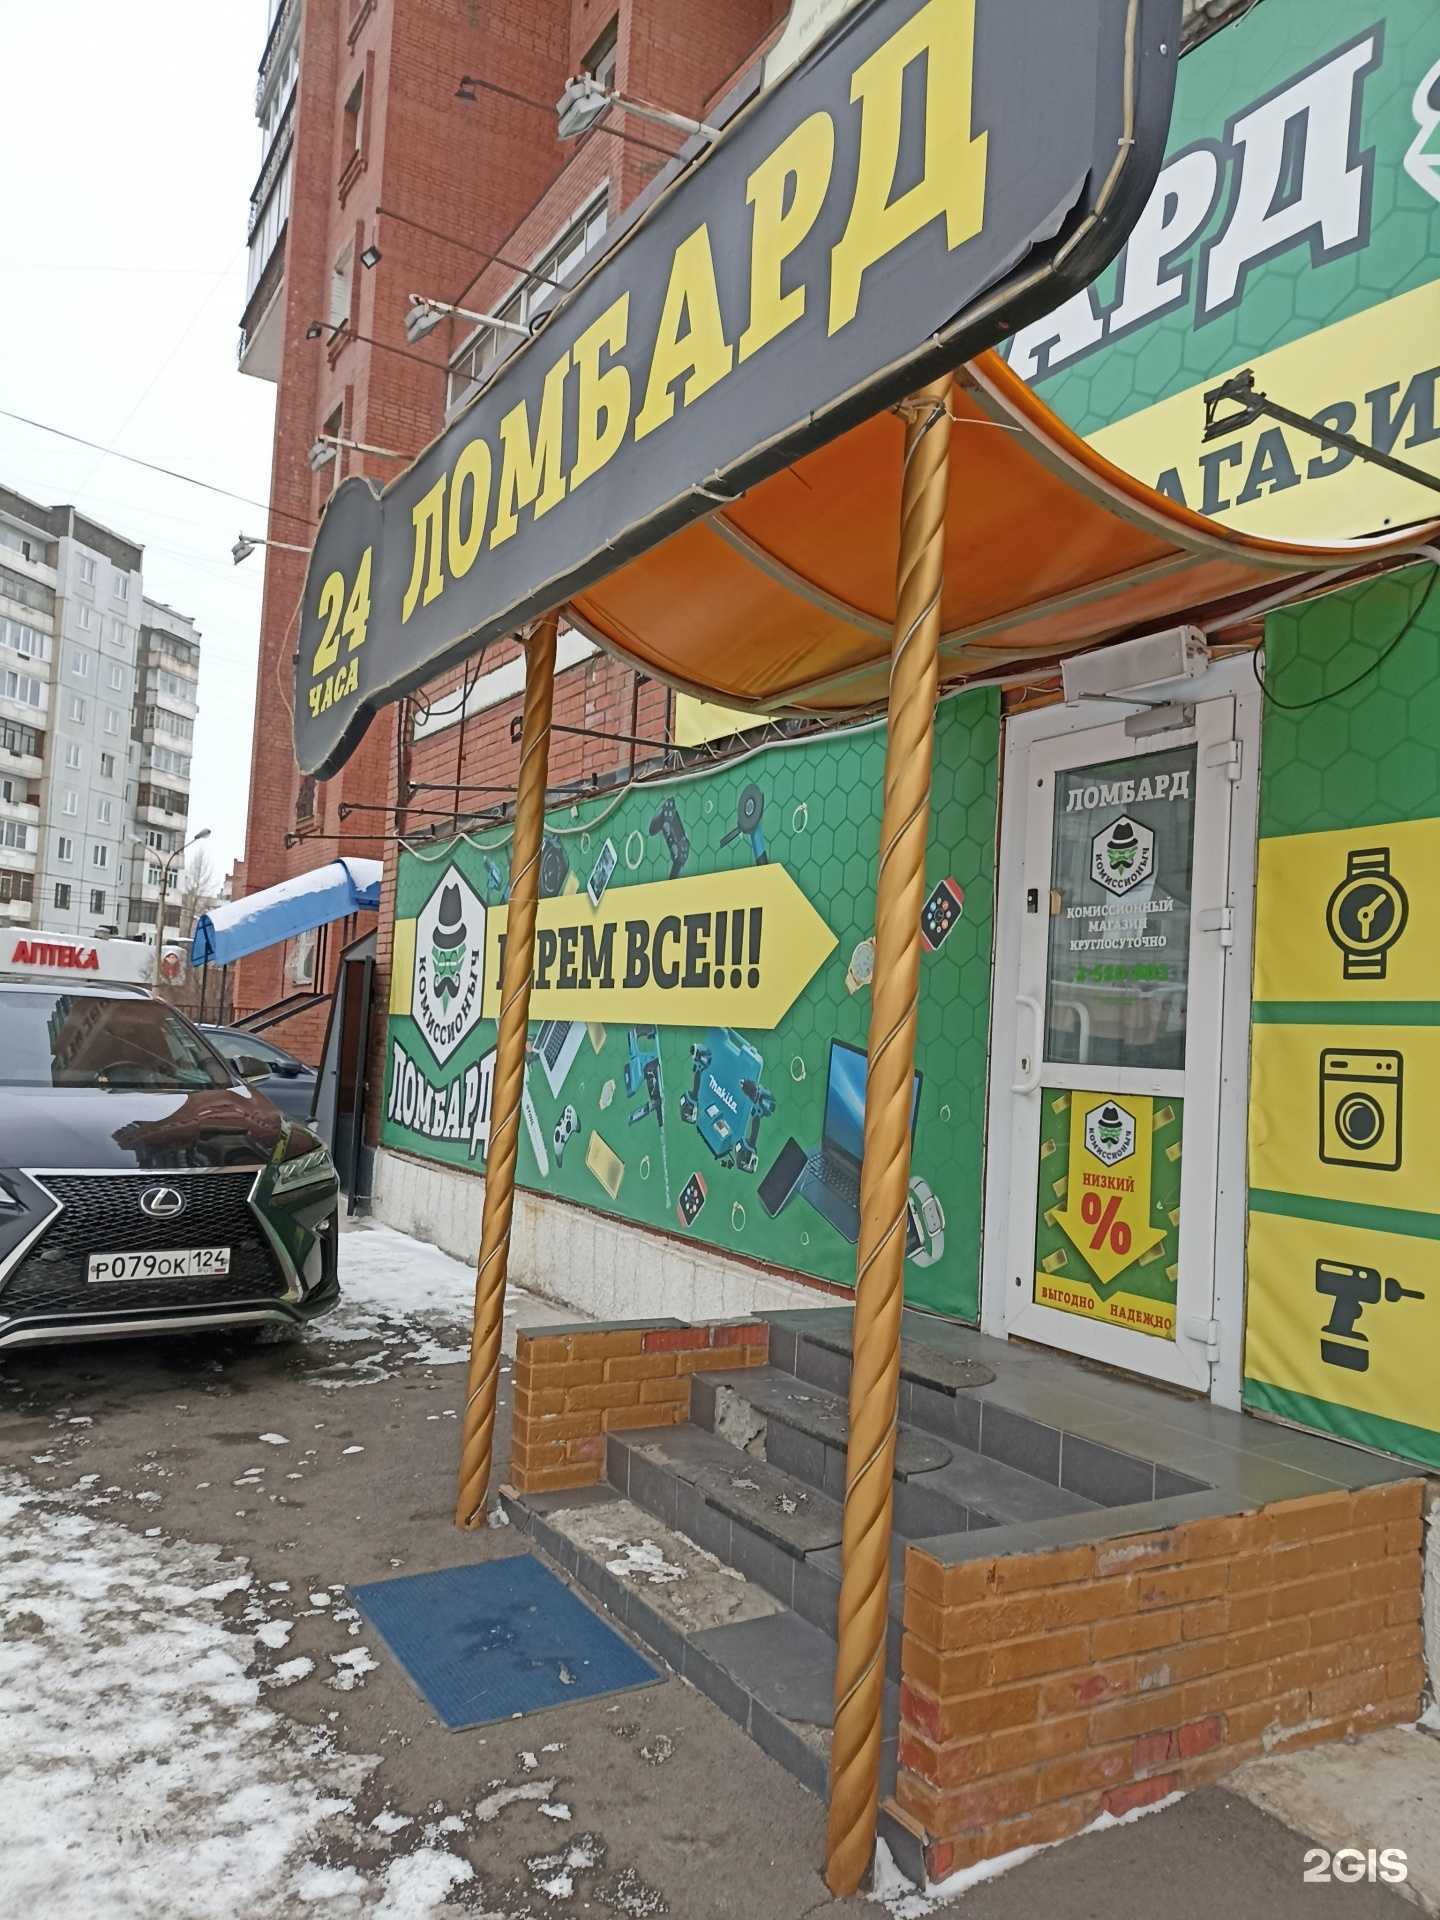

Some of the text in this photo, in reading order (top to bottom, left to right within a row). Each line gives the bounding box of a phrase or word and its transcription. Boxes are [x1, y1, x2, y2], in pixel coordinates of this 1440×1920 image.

[402, 0, 989, 625] ЛОМБАРД
[311, 546, 373, 677] 24
[309, 656, 360, 717] ЧАСА
[1066, 771, 1190, 812] ЛОМБАРД
[1066, 896, 1174, 920] КОМИССИОННЫЙ
[1088, 917, 1148, 934] МАГАЗИН
[11, 939, 99, 970] АПТЕКА
[496, 906, 763, 990] РЕМ ВСЕ!!!
[1069, 934, 1167, 951] КРУГЛОСУТОЧНО
[418, 949, 480, 1046] КОМИССИОНЫЧ
[388, 1042, 498, 1160] ЛОМБАРД
[1082, 1172, 1135, 1193] НИЗКИЙ
[1081, 1192, 1132, 1255] %
[95, 1250, 227, 1280] Р079ОК 124
[1041, 1286, 1172, 1331] ВЫГОДНО НАДЕЖНО
